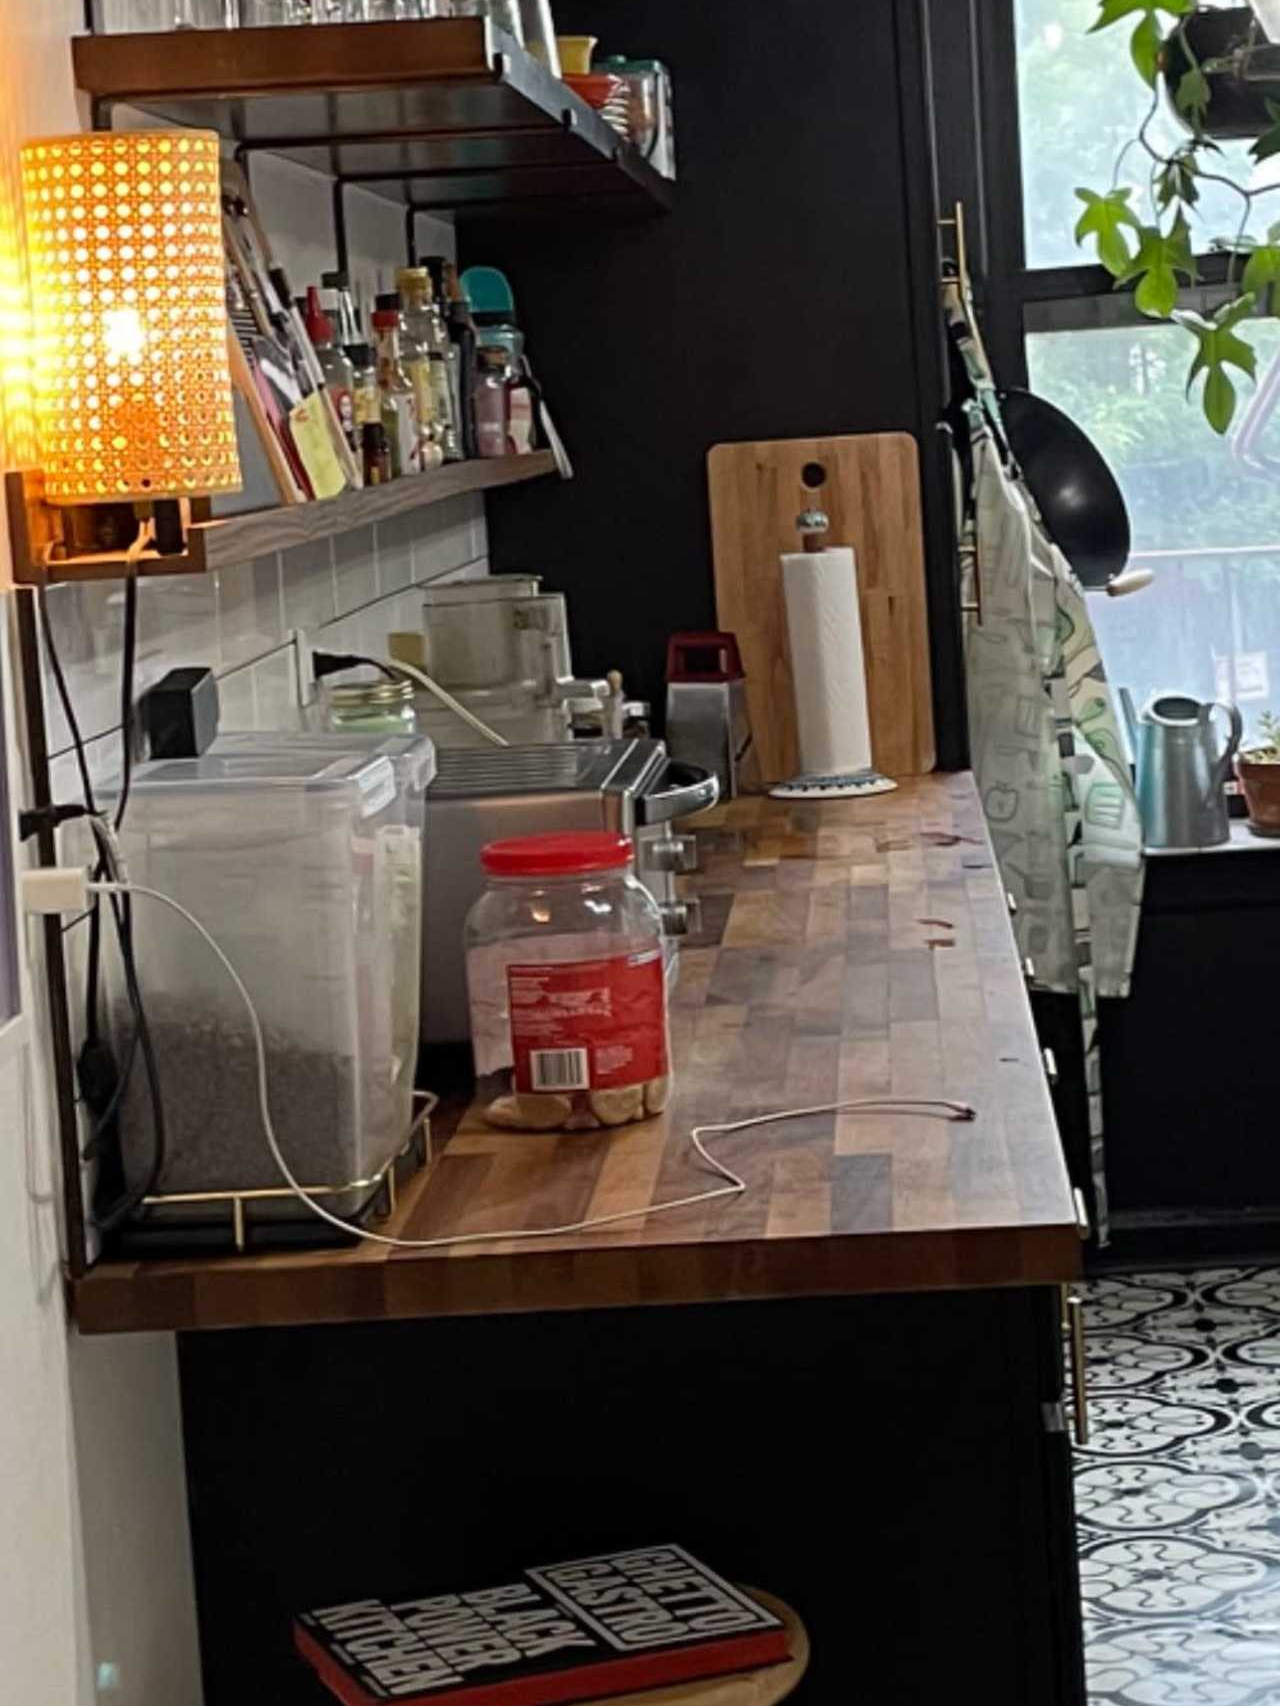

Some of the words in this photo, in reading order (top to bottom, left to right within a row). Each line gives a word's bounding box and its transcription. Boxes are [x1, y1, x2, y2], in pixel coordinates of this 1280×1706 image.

[460, 1583, 597, 1658] BLACK
[546, 1562, 689, 1642] GASTRO
[609, 1548, 762, 1630] GHETTO
[311, 1599, 464, 1695] KITCHEN
[389, 1593, 522, 1673] POWER
